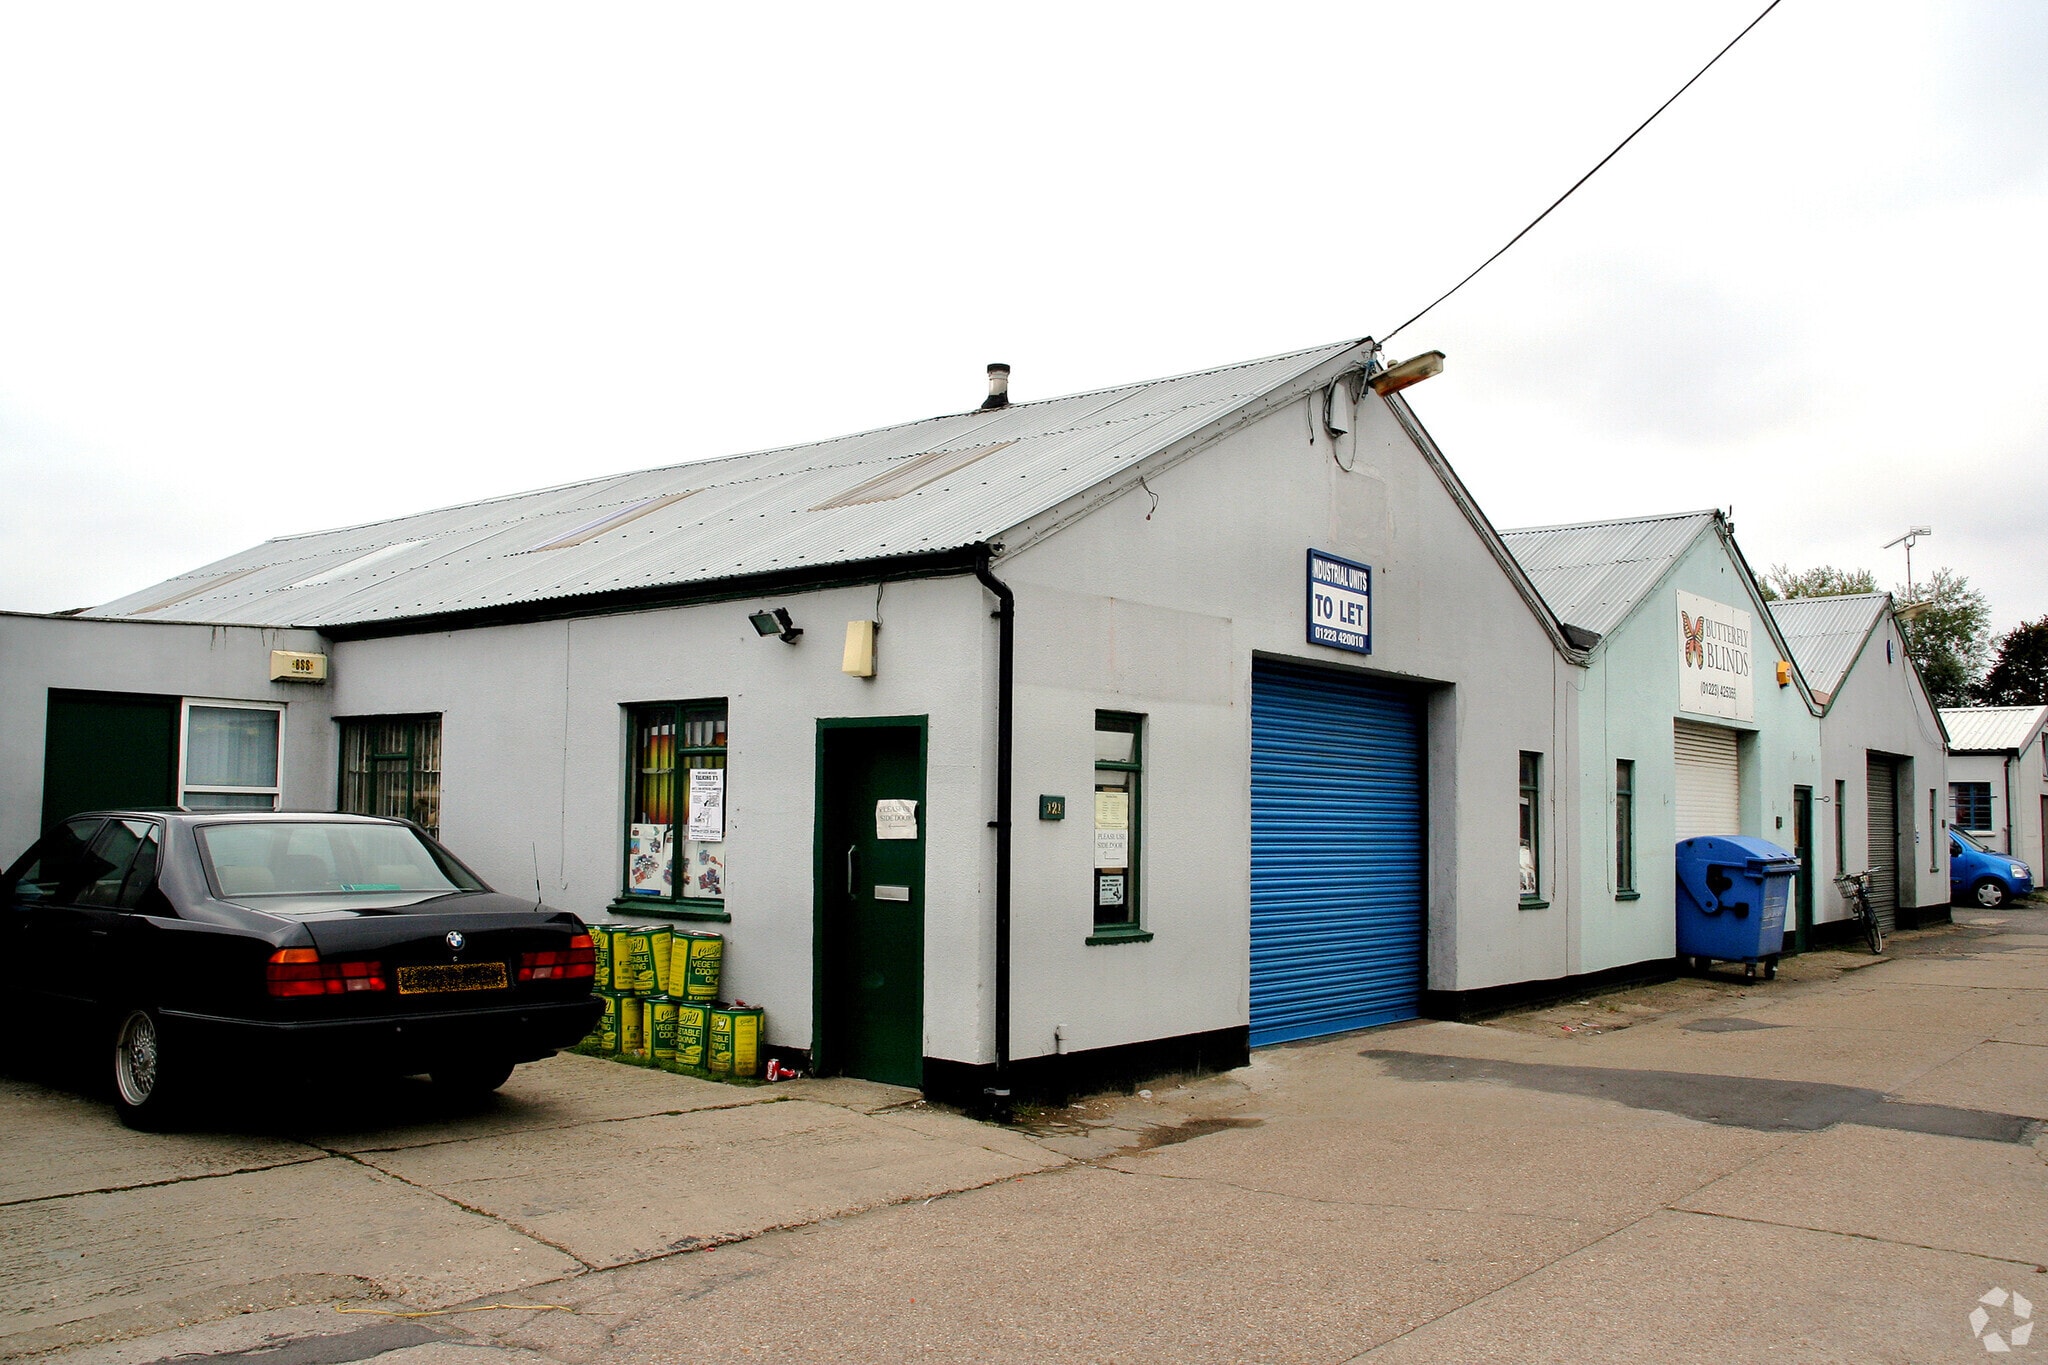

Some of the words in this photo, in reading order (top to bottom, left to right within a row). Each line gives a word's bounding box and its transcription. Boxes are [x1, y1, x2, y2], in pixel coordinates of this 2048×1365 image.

[1312, 558, 1348, 587] INDUSTRIAL
[1348, 569, 1368, 592] UNITS
[1315, 593, 1333, 619] TO
[1339, 599, 1364, 626] LET
[1315, 626, 1337, 642] 01223
[1338, 632, 1364, 648] 420010
[1705, 618, 1749, 648] BUTTERFLY
[1707, 642, 1749, 677] BLINDS
[1047, 801, 1061, 814] 121
